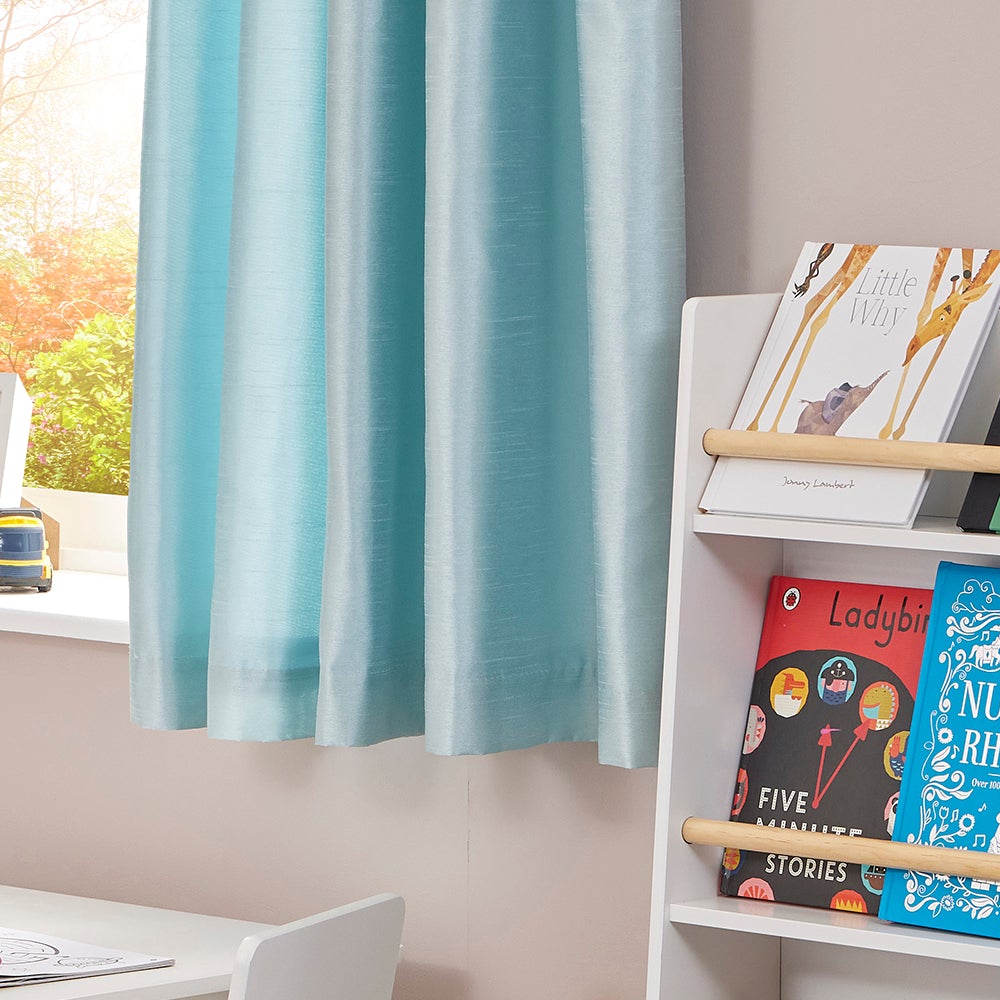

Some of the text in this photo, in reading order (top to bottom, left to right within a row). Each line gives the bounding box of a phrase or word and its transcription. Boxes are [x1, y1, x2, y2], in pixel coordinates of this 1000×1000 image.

[856, 267, 918, 298] Little
[850, 297, 908, 336] Why
[971, 777, 989, 788] Over
[758, 786, 809, 814] FIVE
[765, 853, 848, 883] STORIES
